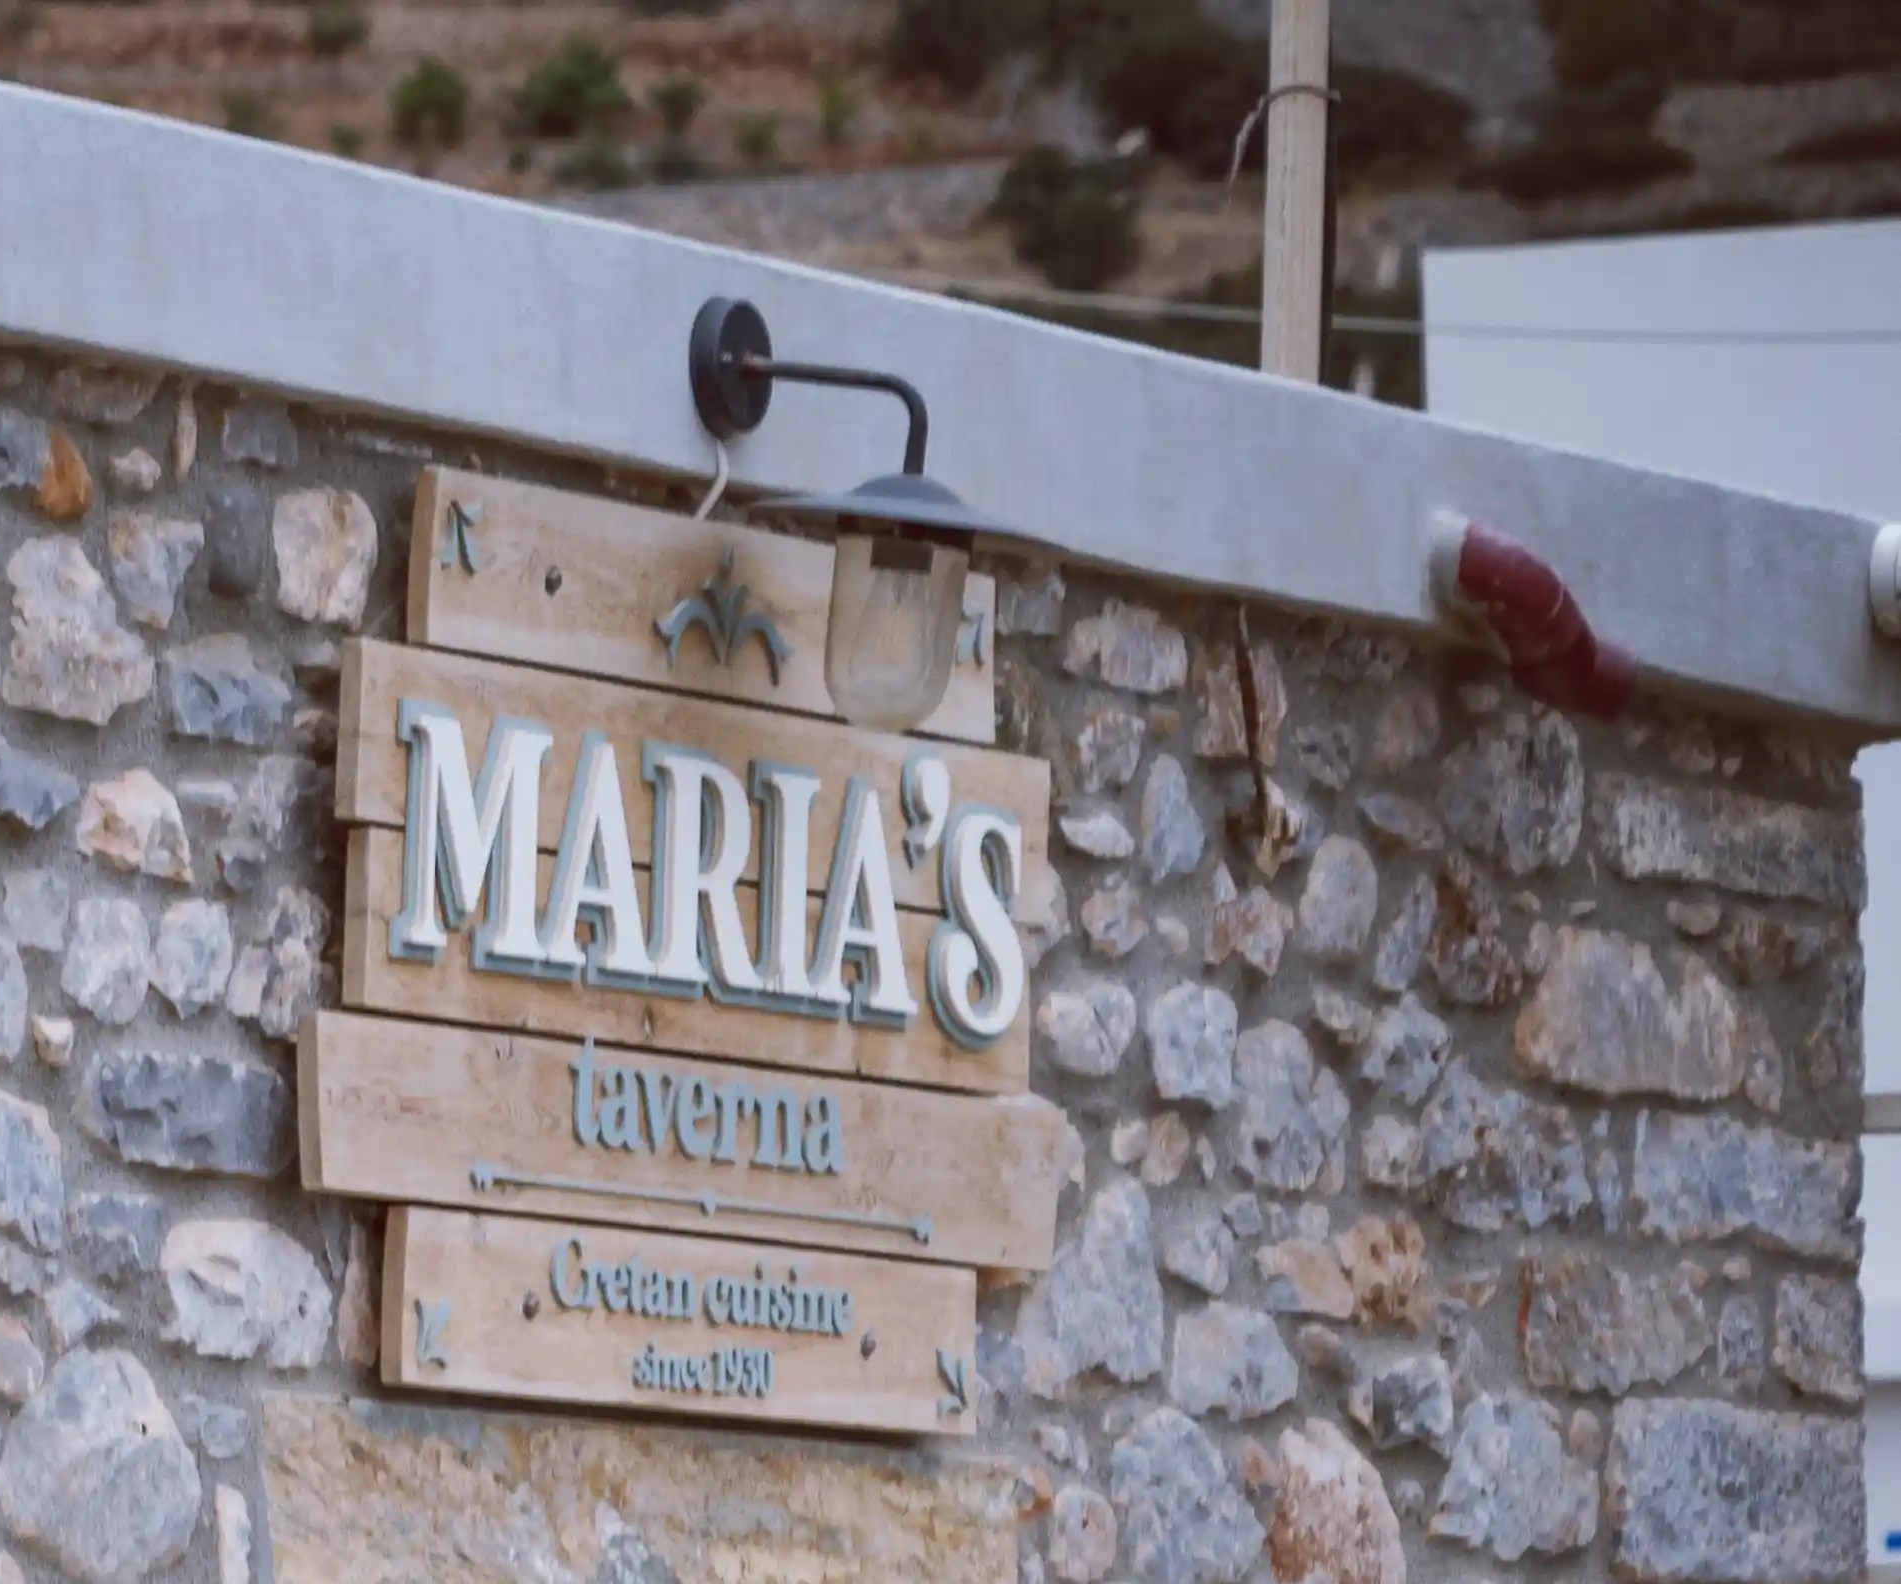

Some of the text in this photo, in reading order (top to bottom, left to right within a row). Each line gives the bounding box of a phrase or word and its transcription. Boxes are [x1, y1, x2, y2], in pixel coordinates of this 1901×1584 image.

[388, 698, 1024, 1049] MARIA'S
[568, 1033, 845, 1176] taverna
[550, 1238, 853, 1336] Cretan cuisine
[632, 1341, 711, 1392] since
